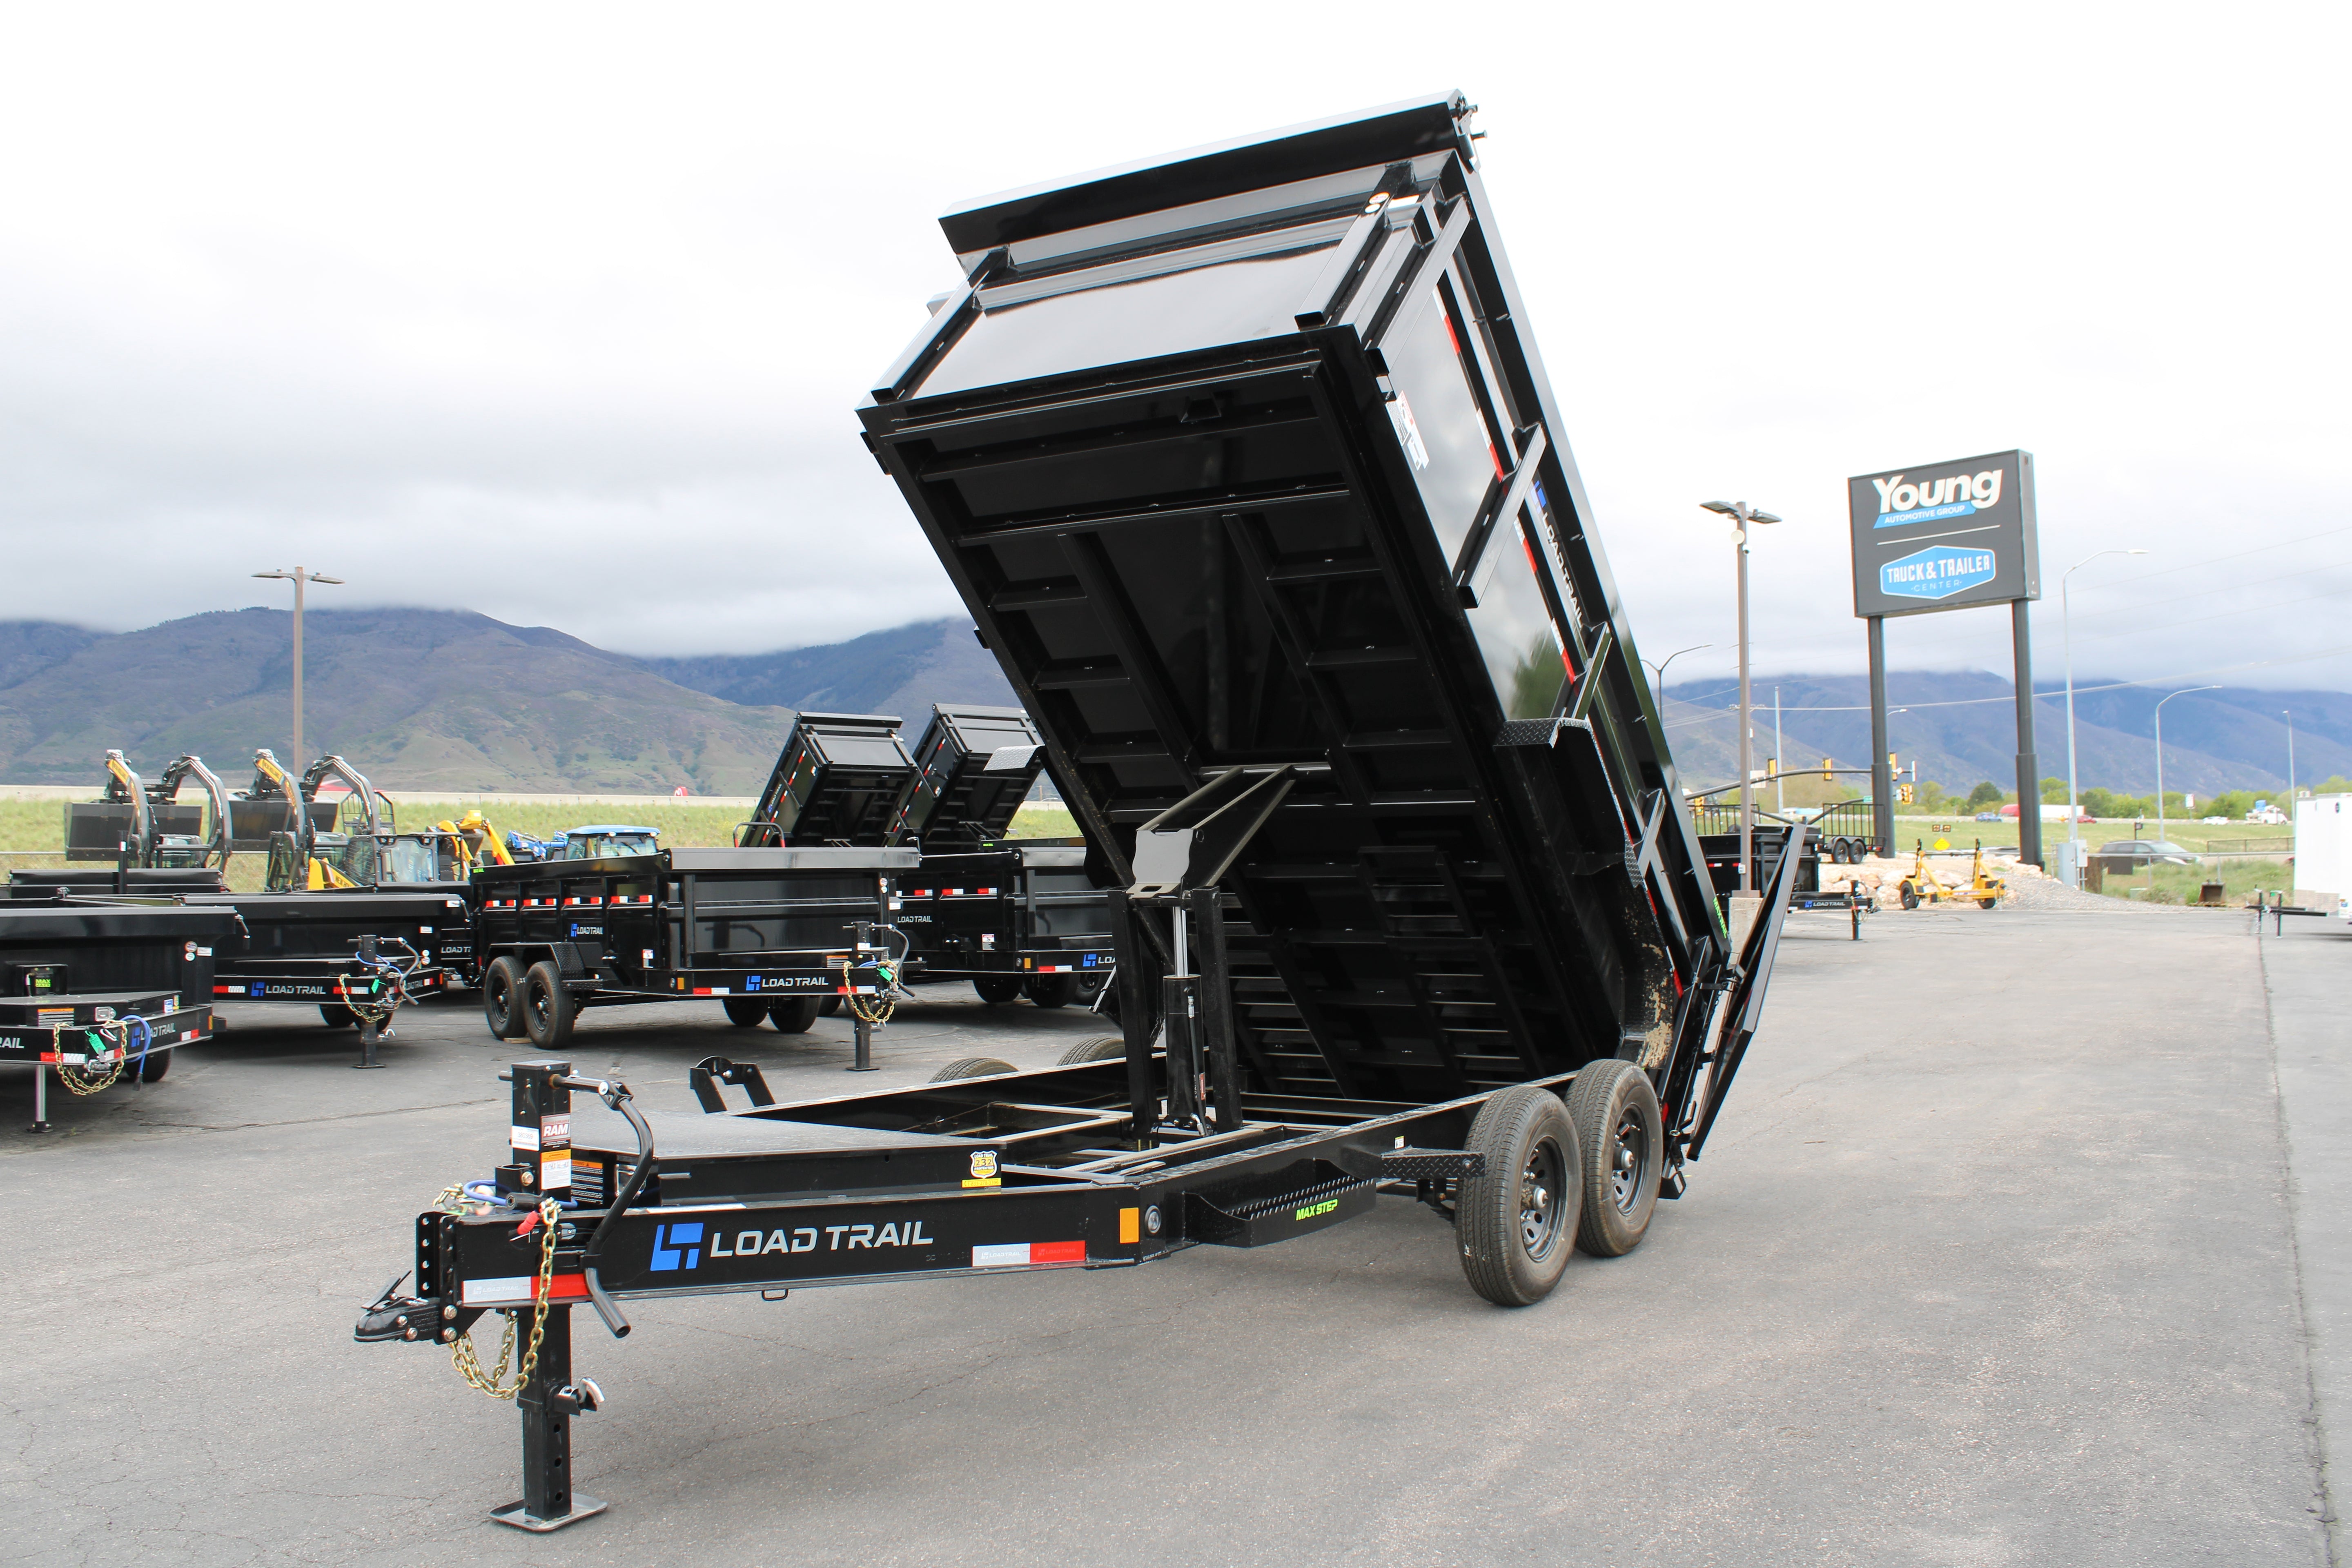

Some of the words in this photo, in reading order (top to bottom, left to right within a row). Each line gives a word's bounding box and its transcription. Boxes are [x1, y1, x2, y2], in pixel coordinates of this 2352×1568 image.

[1872, 469, 2002, 514] Young
[1884, 509, 1935, 523] AUTOMOTIVE
[1936, 505, 1965, 516] GROUP
[1543, 512, 1564, 569] LOAD
[1563, 567, 1582, 628] TRAIL
[1886, 563, 1925, 583] TRUCK
[1926, 561, 1937, 579] &
[1938, 555, 1990, 578] TRAILER
[1913, 579, 1960, 592] CENTER
[266, 985, 294, 993] LOAD
[296, 986, 326, 994] TRAIL
[762, 978, 794, 987] LOAD
[795, 977, 829, 986] TRAIL
[140, 1027, 158, 1041] LAD
[158, 1023, 176, 1036] TRAIL
[543, 1123, 569, 1137] RAM
[1296, 1205, 1316, 1221] MAX
[1316, 1198, 1338, 1215] STEP
[710, 1227, 817, 1257] LOAD
[826, 1221, 933, 1250] TRAIL
